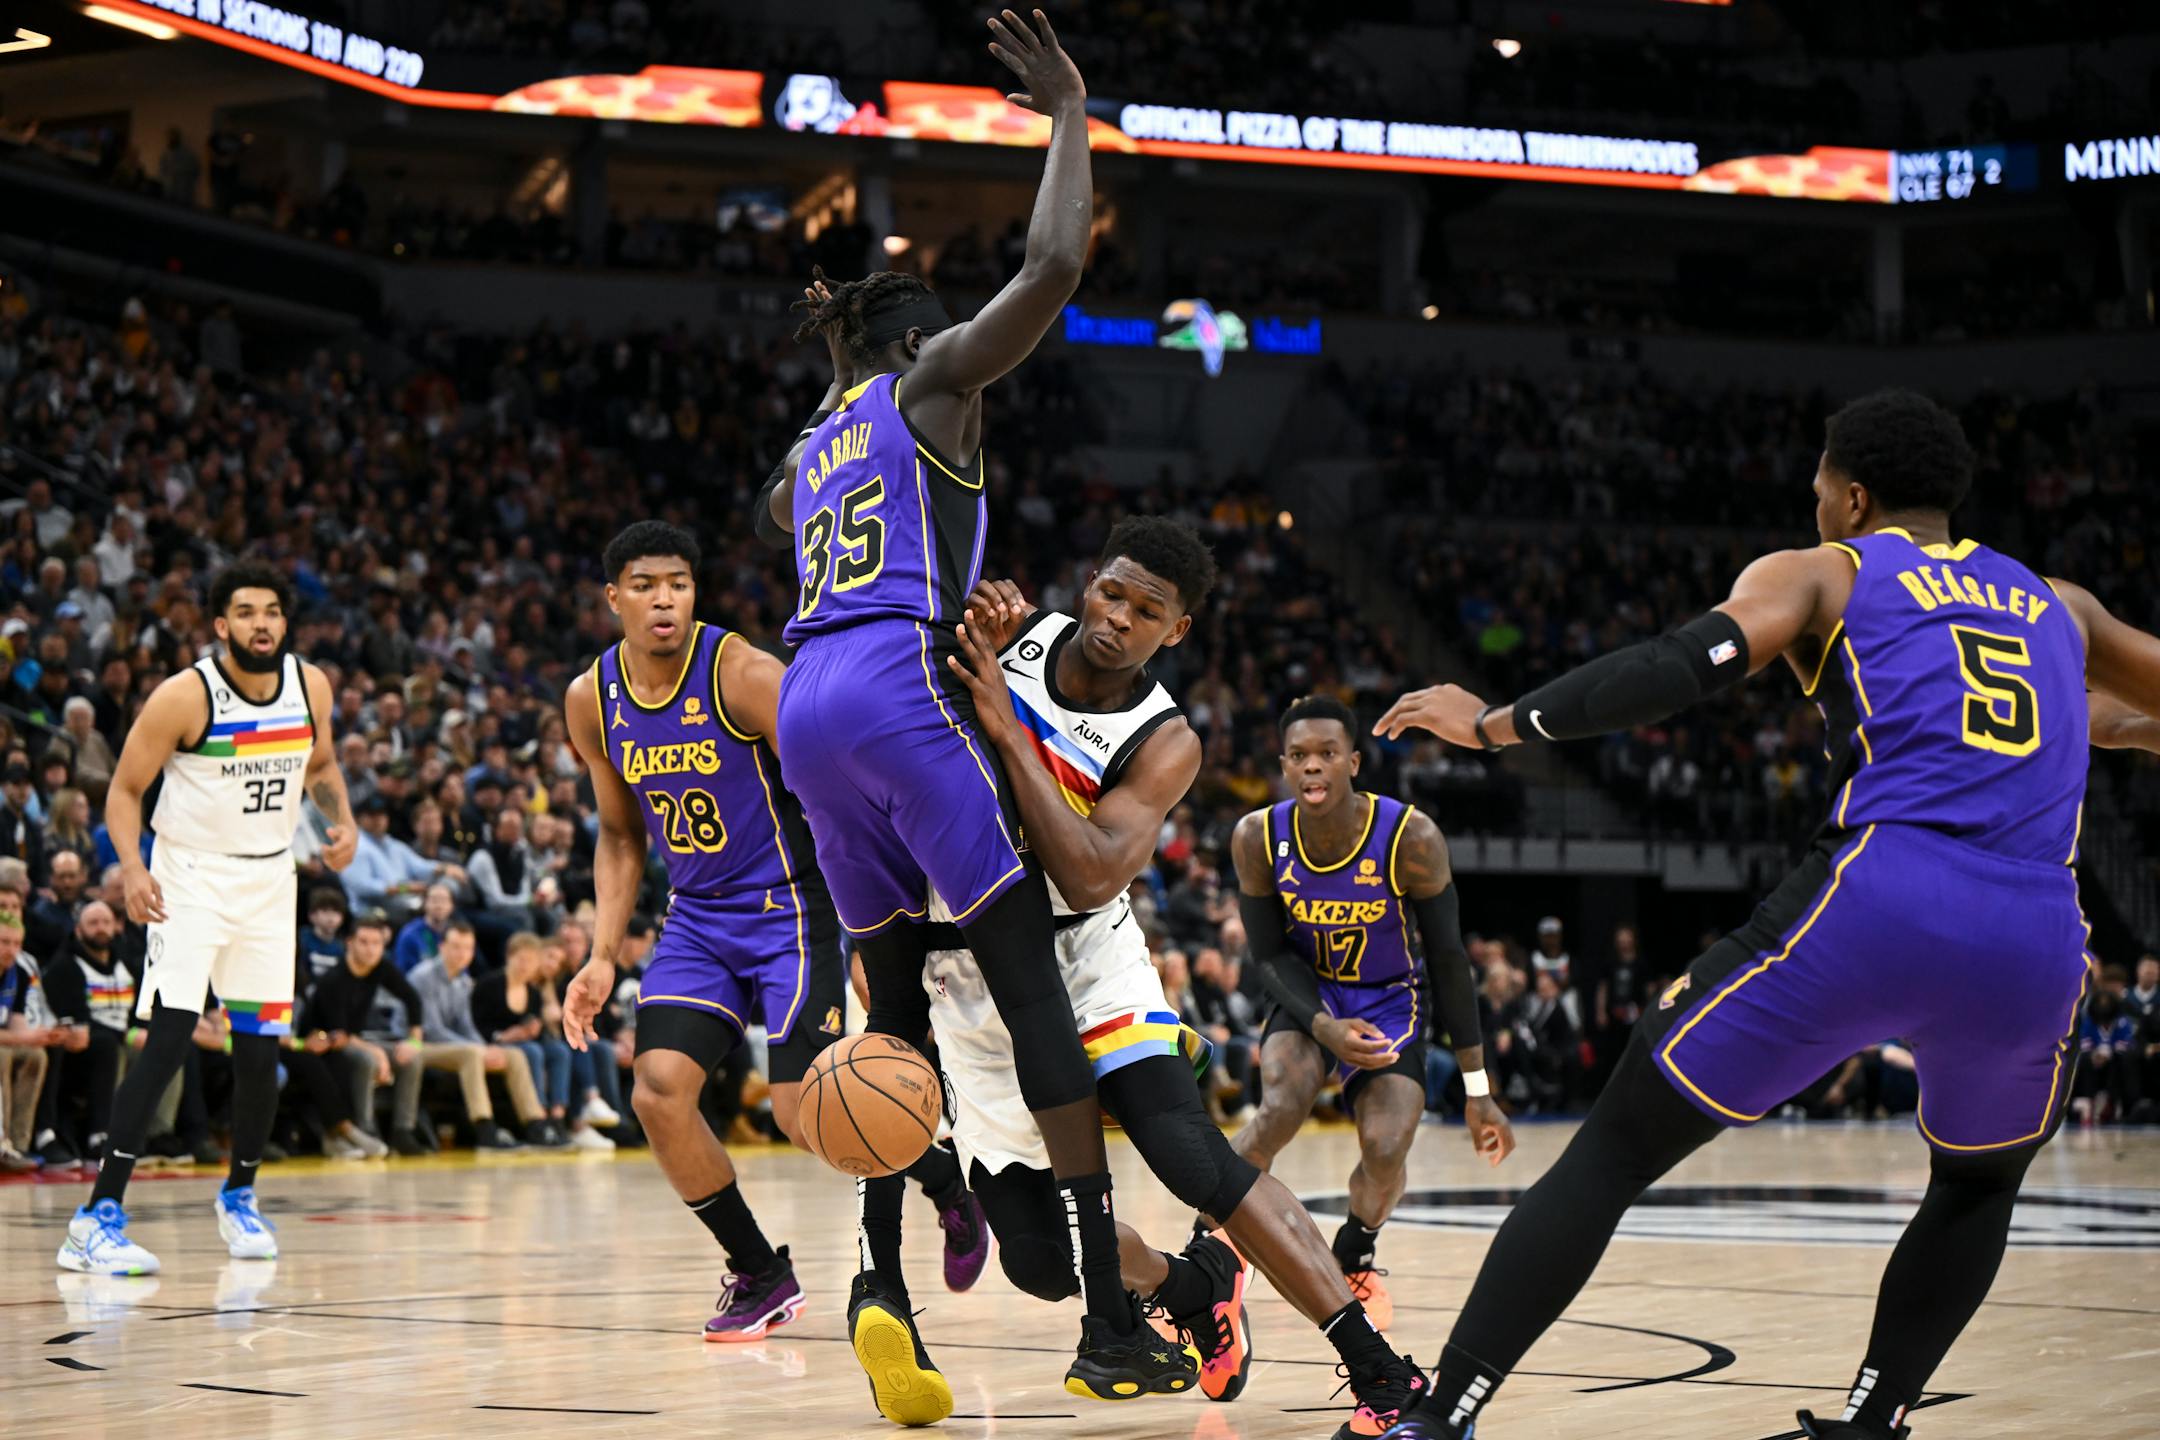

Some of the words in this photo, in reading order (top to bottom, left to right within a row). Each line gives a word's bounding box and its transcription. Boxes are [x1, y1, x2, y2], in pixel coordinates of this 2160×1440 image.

[222, 0, 309, 52] SECTIONS
[343, 33, 384, 76] AND
[1120, 104, 1225, 144] OFFICIAL
[1227, 111, 1301, 149] PIZZA
[1302, 116, 1340, 151] OF
[1341, 119, 1386, 155] THE
[1387, 122, 1525, 163] MINNESOTA
[1524, 131, 1699, 176] TIMBERWOLVES
[1946, 150, 1973, 174] 71
[1899, 176, 1942, 202] CLE
[1984, 158, 2001, 184] 2
[806, 422, 873, 494] GABRIEL
[797, 474, 886, 622] 35
[1896, 565, 2049, 625] BEASLEY
[1021, 643, 1041, 661] 6
[608, 682, 618, 699] 6
[1949, 623, 2041, 757] 5
[620, 738, 721, 784] LAKERS
[243, 778, 285, 813] 32
[645, 787, 728, 853] 28
[1278, 841, 1289, 857] 6
[1313, 926, 1368, 982] 17
